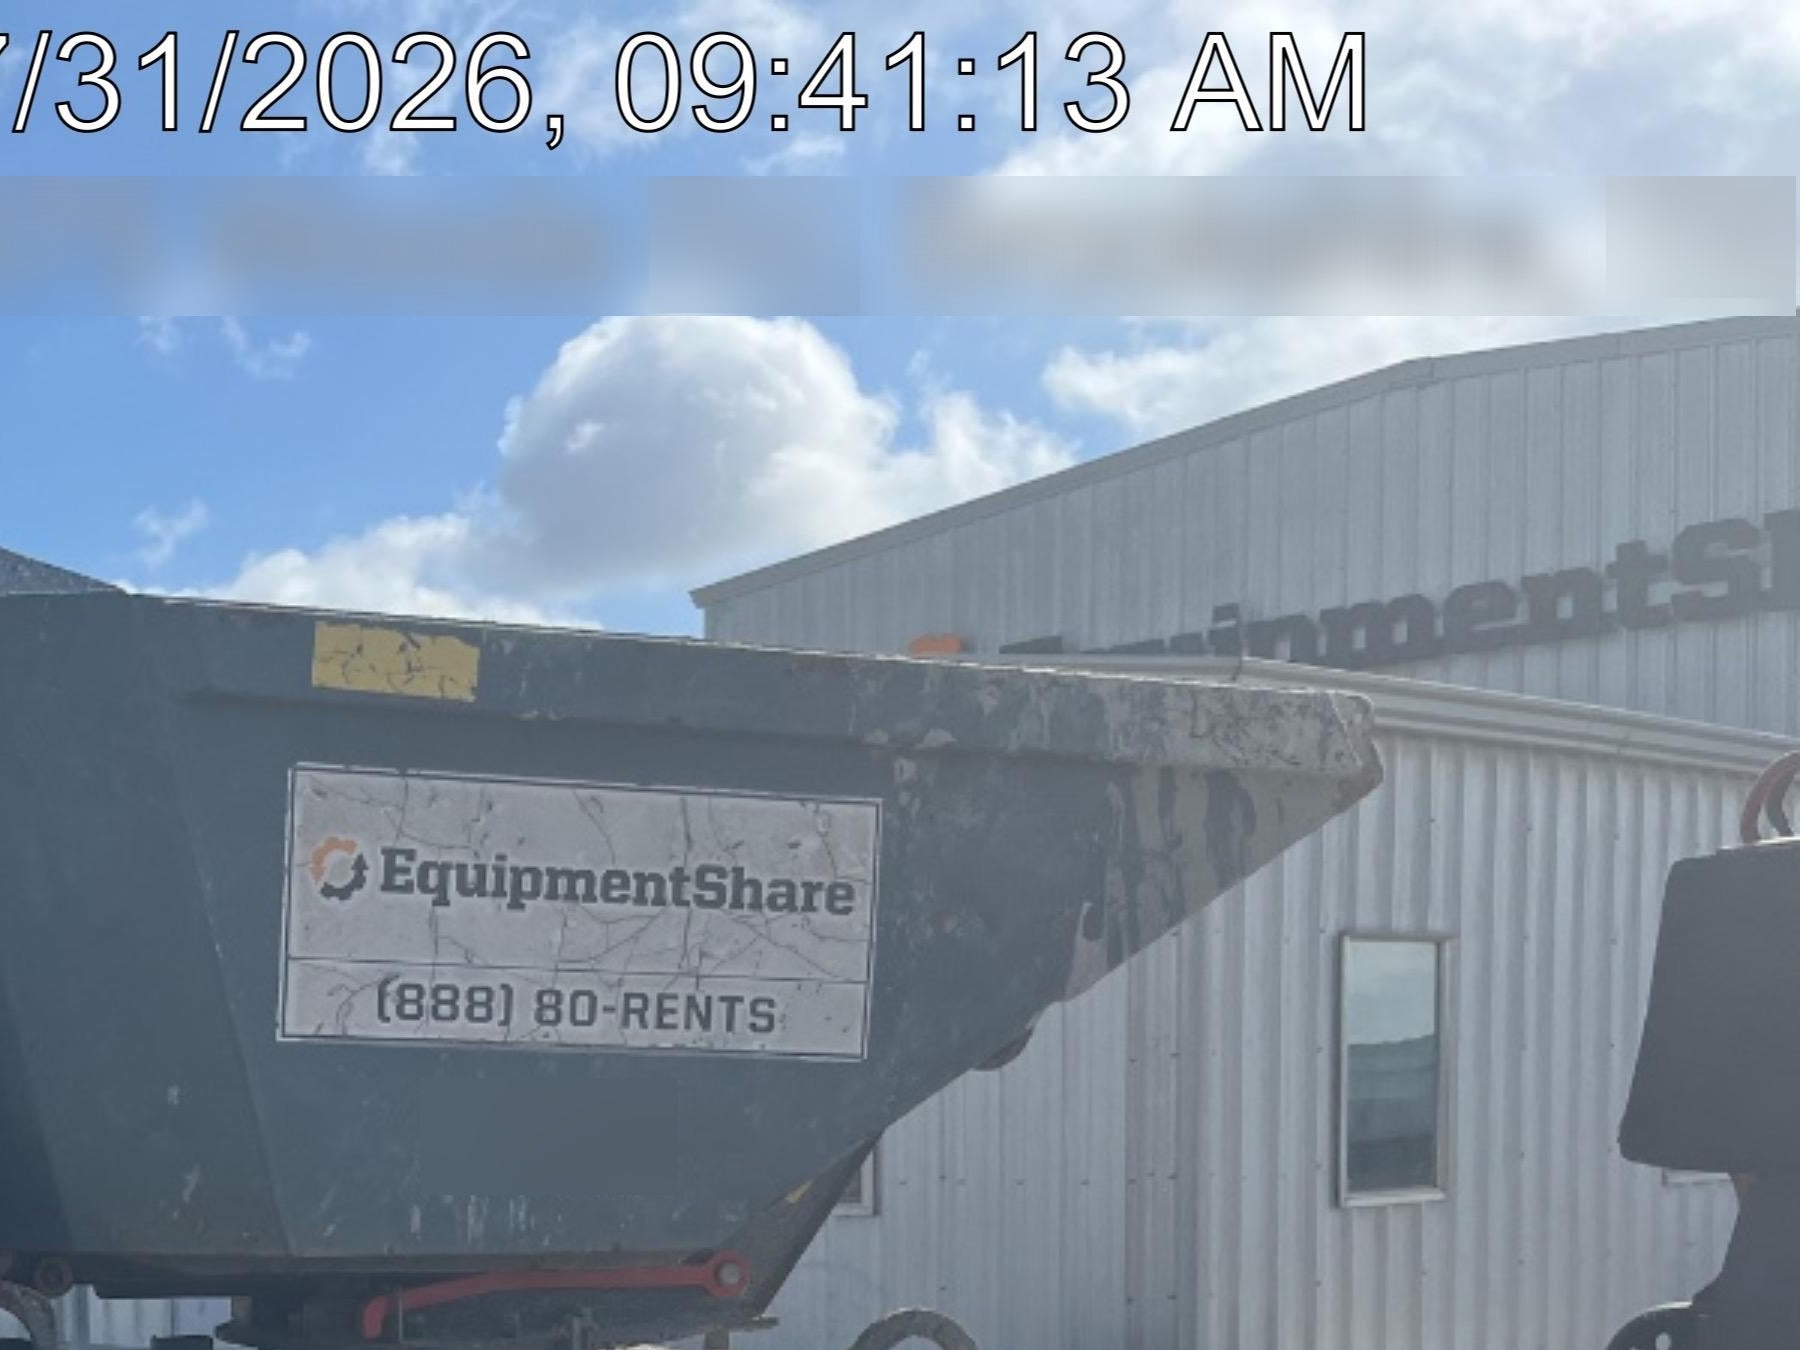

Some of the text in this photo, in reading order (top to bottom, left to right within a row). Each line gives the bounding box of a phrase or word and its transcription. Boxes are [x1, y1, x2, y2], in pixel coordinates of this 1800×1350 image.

[379, 847, 855, 916] EquipmentShare
[377, 977, 776, 1034] (888) 80-RENTS
